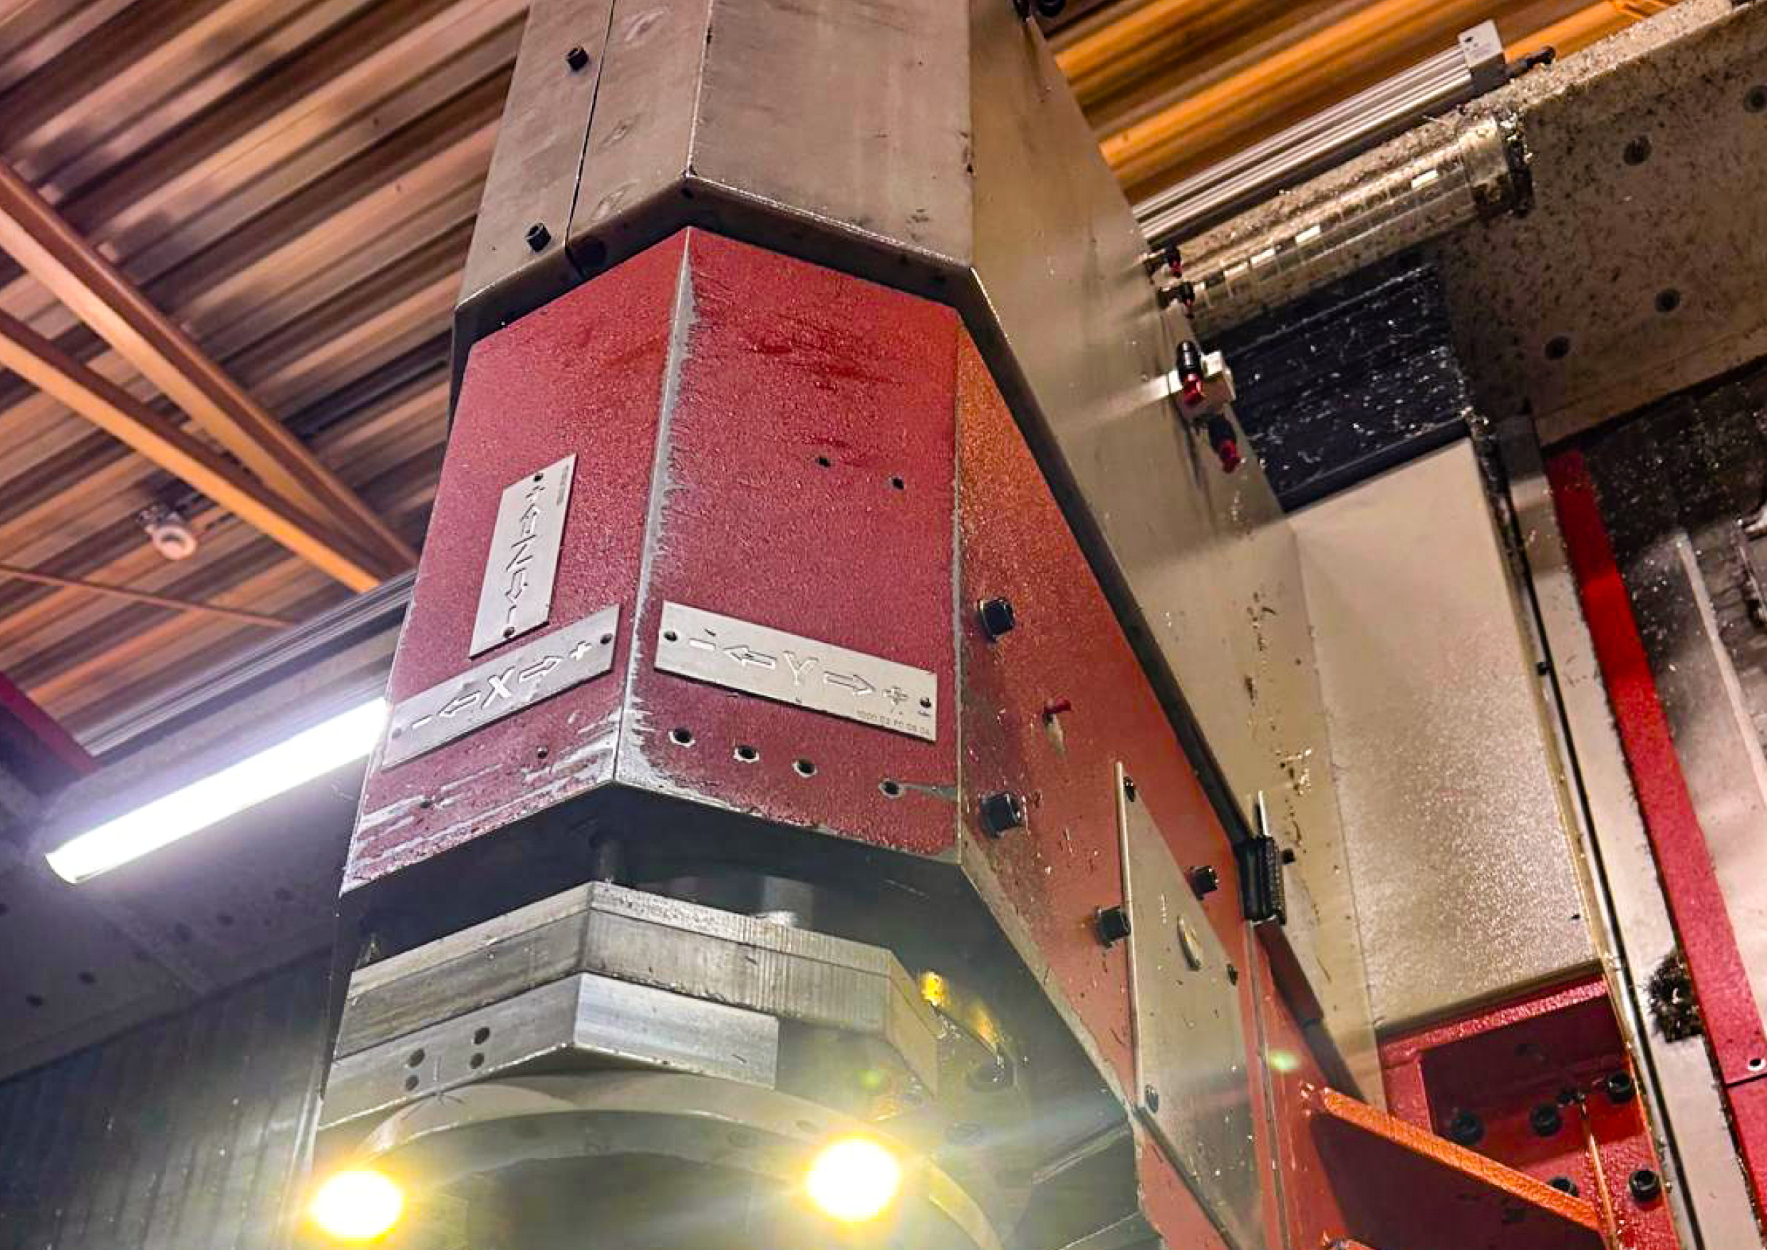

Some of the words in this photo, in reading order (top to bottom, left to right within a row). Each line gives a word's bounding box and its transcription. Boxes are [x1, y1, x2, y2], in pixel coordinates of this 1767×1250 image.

[505, 534, 537, 572] Z
[783, 650, 820, 686] Y
[480, 665, 517, 710] X
